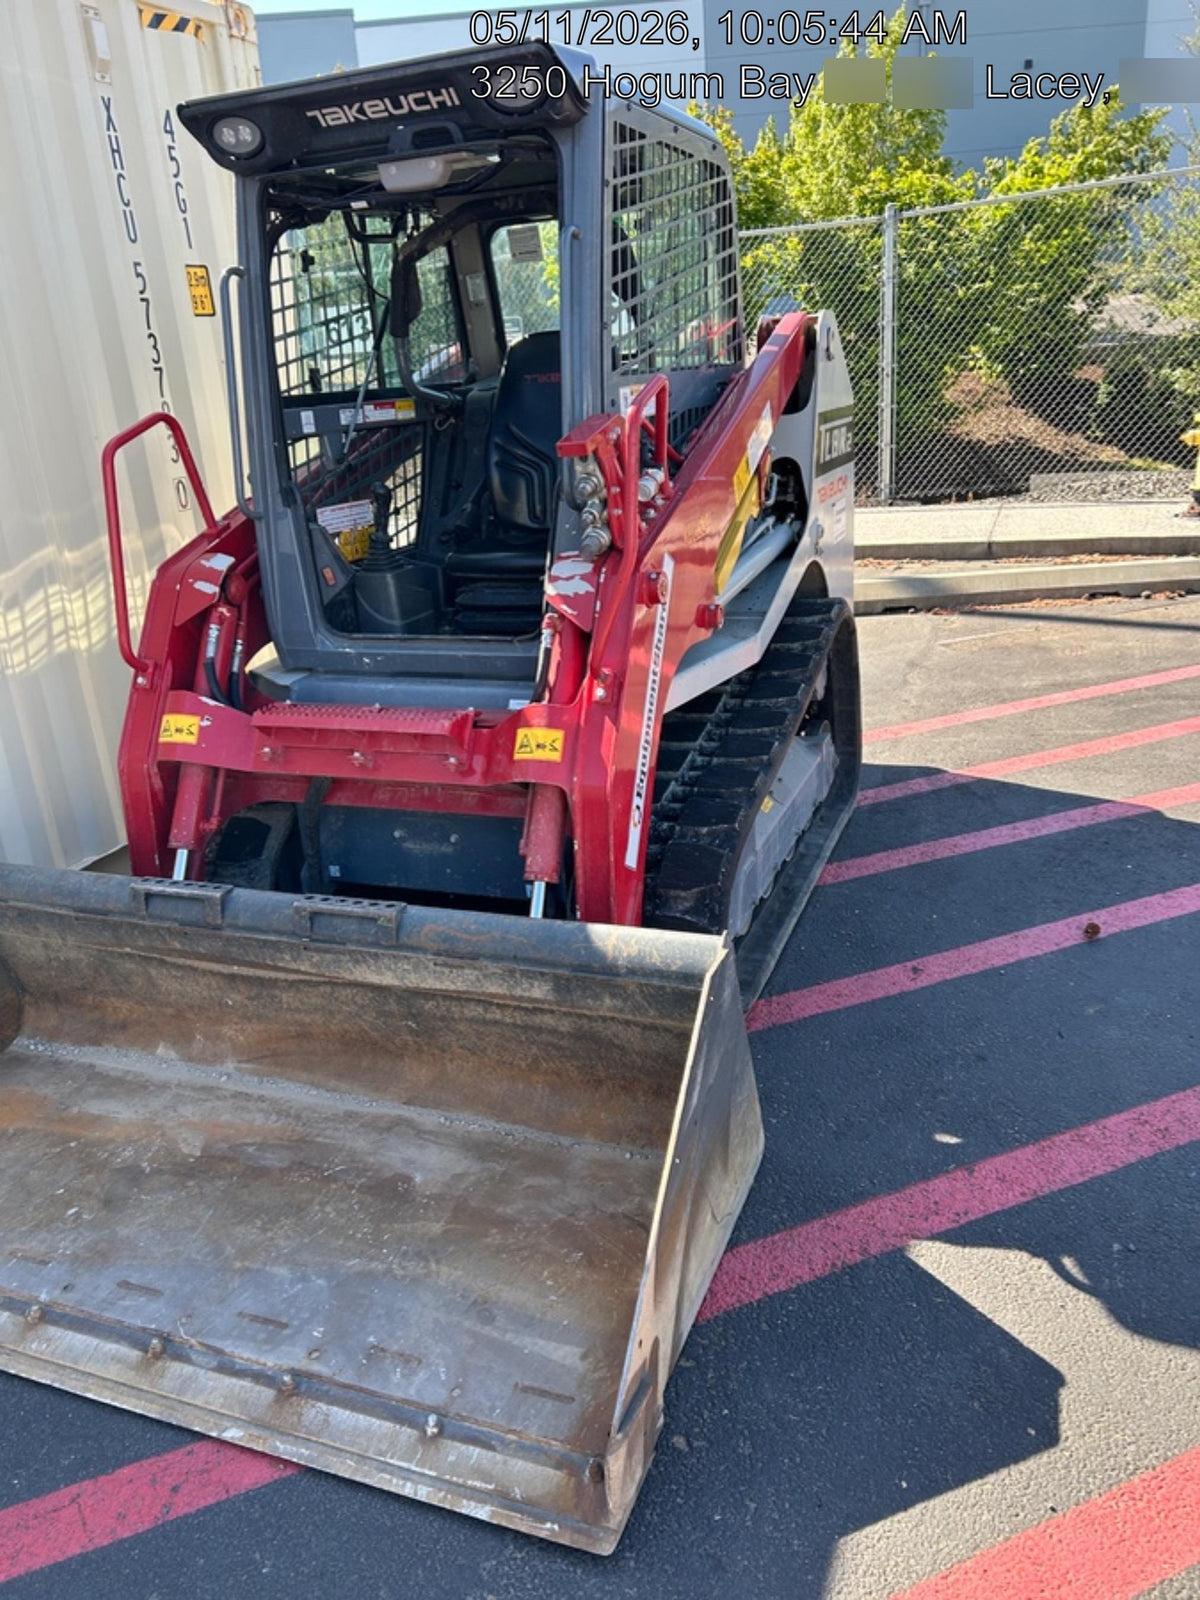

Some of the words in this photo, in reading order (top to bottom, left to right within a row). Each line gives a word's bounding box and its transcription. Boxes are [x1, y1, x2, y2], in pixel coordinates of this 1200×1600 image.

[305, 87, 461, 127] TAKEUCHI
[163, 109, 193, 249] 45G1
[101, 95, 138, 244] XHCU
[132, 261, 180, 464] 57373
